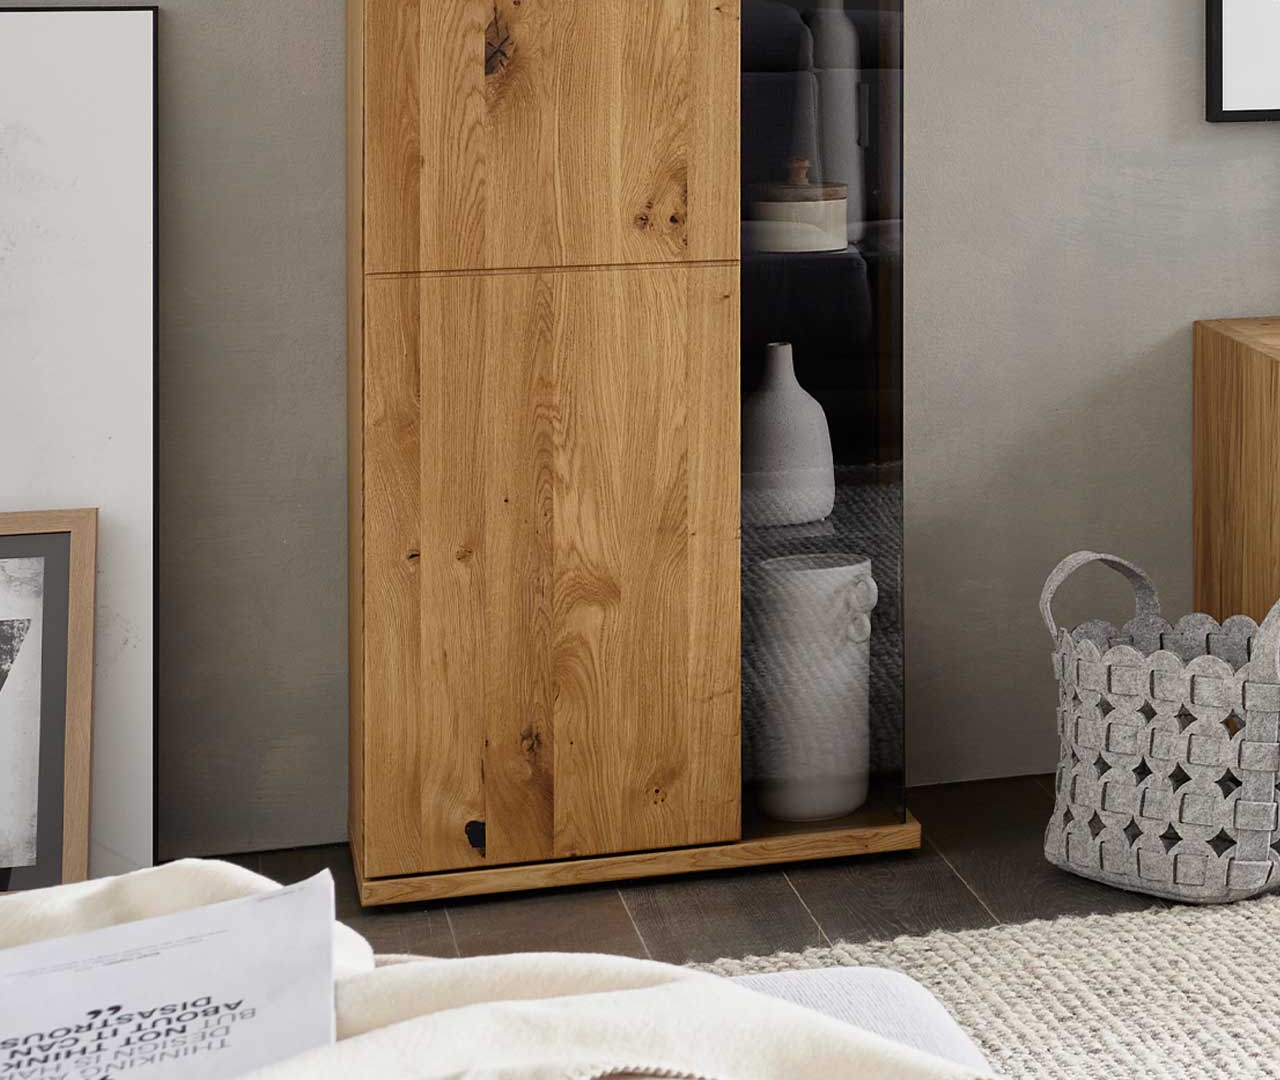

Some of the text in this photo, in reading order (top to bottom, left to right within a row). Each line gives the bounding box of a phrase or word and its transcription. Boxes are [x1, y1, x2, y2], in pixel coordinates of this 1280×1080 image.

[0, 995, 213, 1051] DISASTROUS
[3, 1006, 257, 1071] BUT NOT THINK
[9, 998, 245, 1060] ABOUT IT CAN
[113, 1024, 231, 1059] DESIGN
[74, 1054, 101, 1071] IS
[80, 1037, 233, 1076] THINKING
